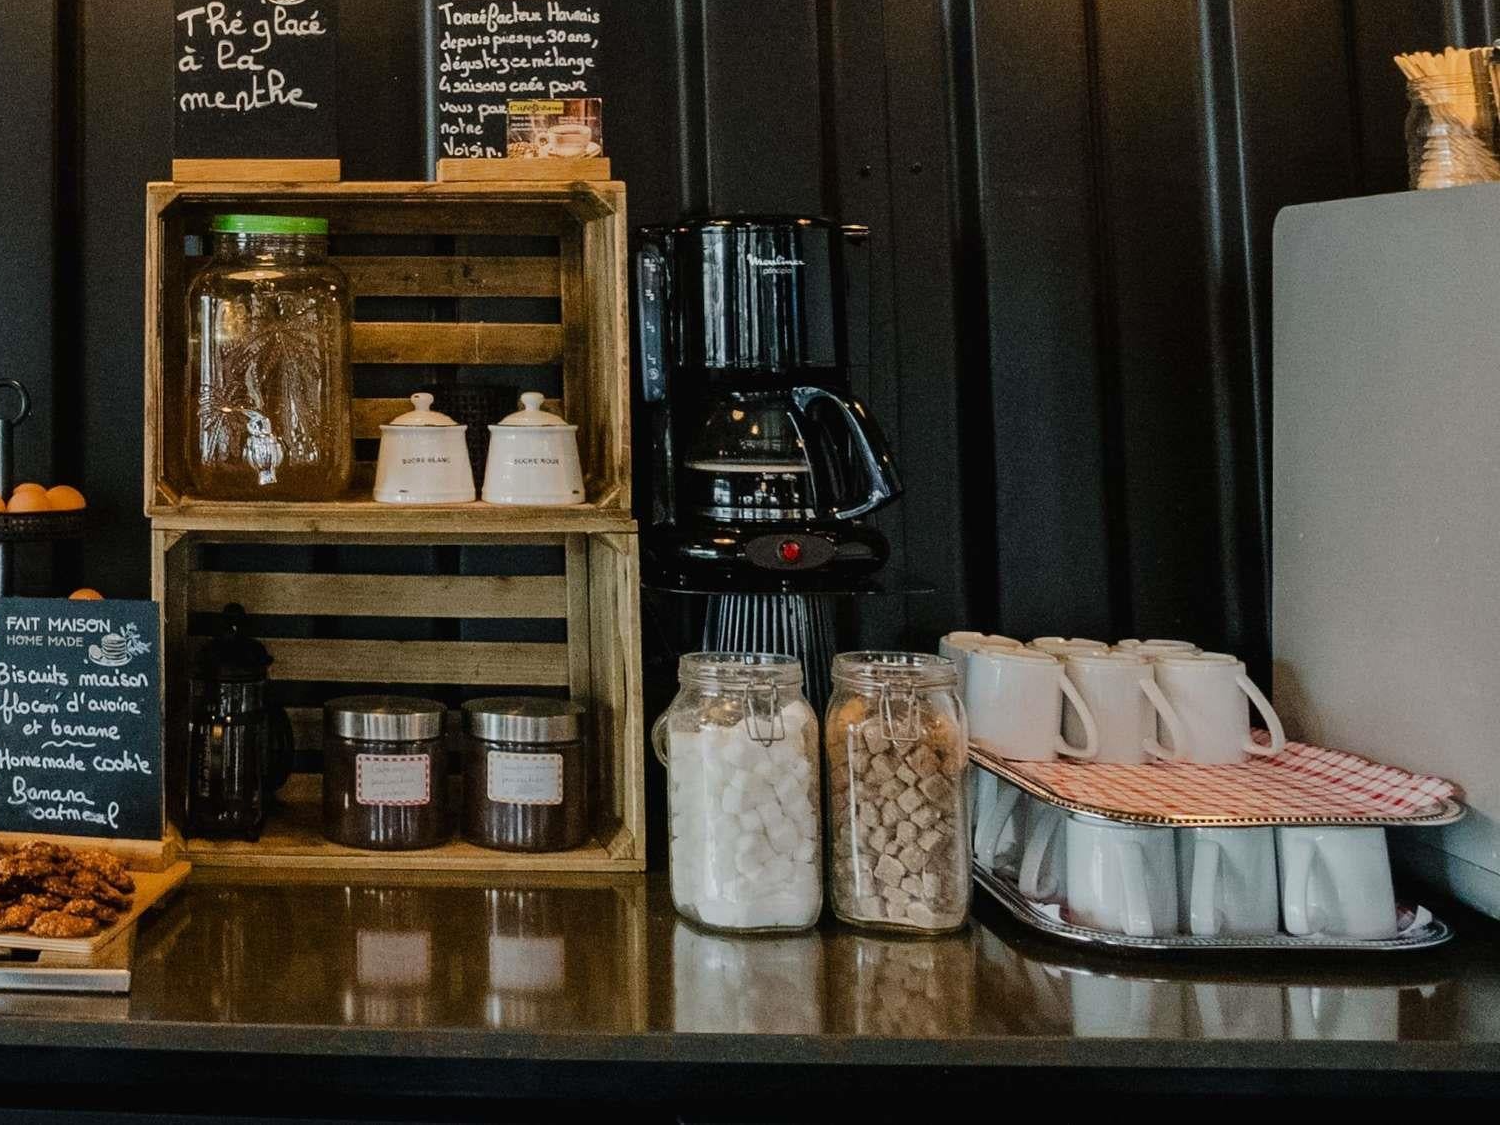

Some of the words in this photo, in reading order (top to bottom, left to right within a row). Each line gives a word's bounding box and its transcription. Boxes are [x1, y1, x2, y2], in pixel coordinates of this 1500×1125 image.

[177, 1, 247, 36] Thé
[251, 6, 326, 53] glacé
[440, 31, 490, 54] depuis
[546, 29, 566, 43] 30
[178, 45, 203, 72] à
[217, 40, 264, 71] la
[440, 48, 510, 77] dégustez
[510, 57, 531, 67] ce
[532, 46, 595, 75] mélange
[180, 69, 317, 112] menthe
[439, 75, 451, 93] 4
[453, 79, 507, 93] saisons
[549, 80, 588, 99] pour
[439, 102, 473, 114] vous
[477, 103, 508, 123] par
[440, 117, 484, 135] notre
[6, 617, 40, 631] FAIT
[48, 618, 111, 633] MAISON
[6, 635, 43, 646] HOME
[47, 636, 84, 648] MADE
[79, 668, 148, 687] maison
[66, 691, 141, 714] d'avoine
[22, 719, 43, 736] et
[51, 719, 121, 740] banane
[7, 776, 95, 806] Banana
